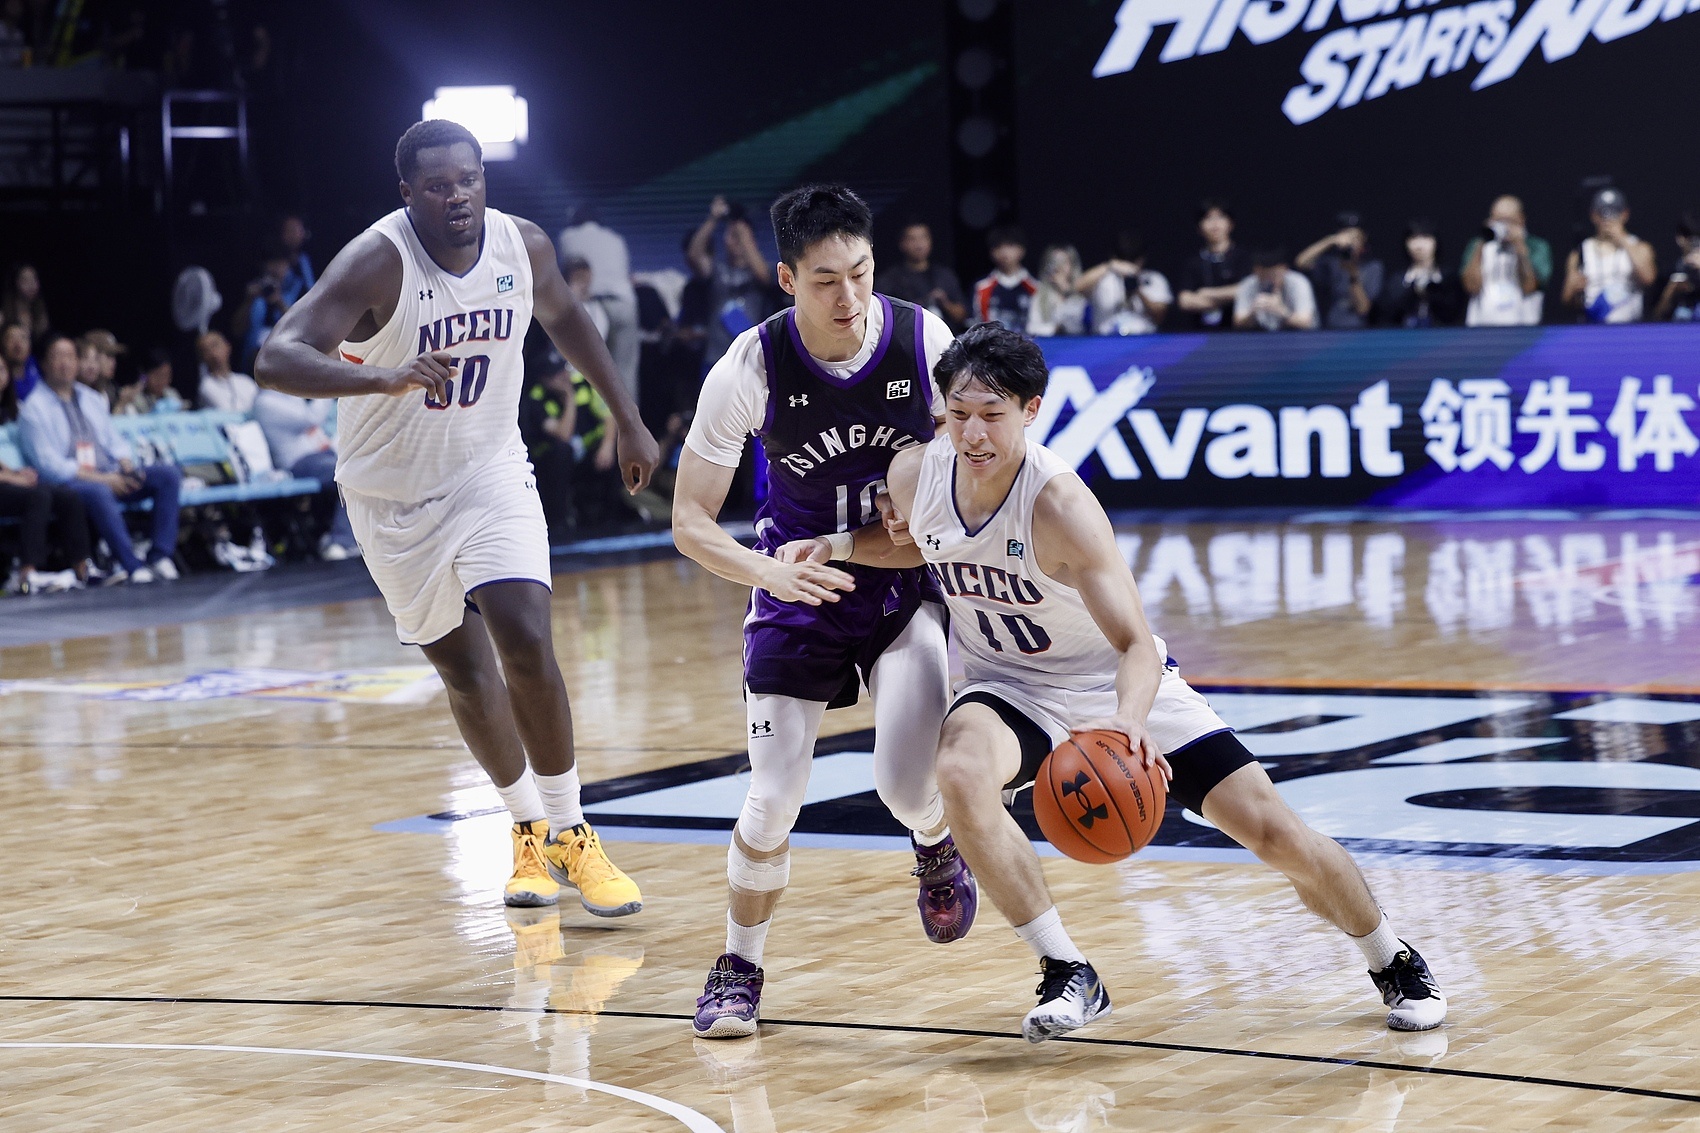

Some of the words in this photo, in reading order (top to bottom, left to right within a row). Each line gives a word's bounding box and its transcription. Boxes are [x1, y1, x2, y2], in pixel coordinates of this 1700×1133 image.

[1281, 0, 1516, 125] STARTS
[418, 309, 513, 355] NCCU
[780, 424, 921, 478] TSINGHU
[927, 562, 1044, 605] NCCU
[974, 609, 1052, 655] 10
[1096, 740, 1134, 779] ARMOUR
[1129, 780, 1147, 823] UNDER
